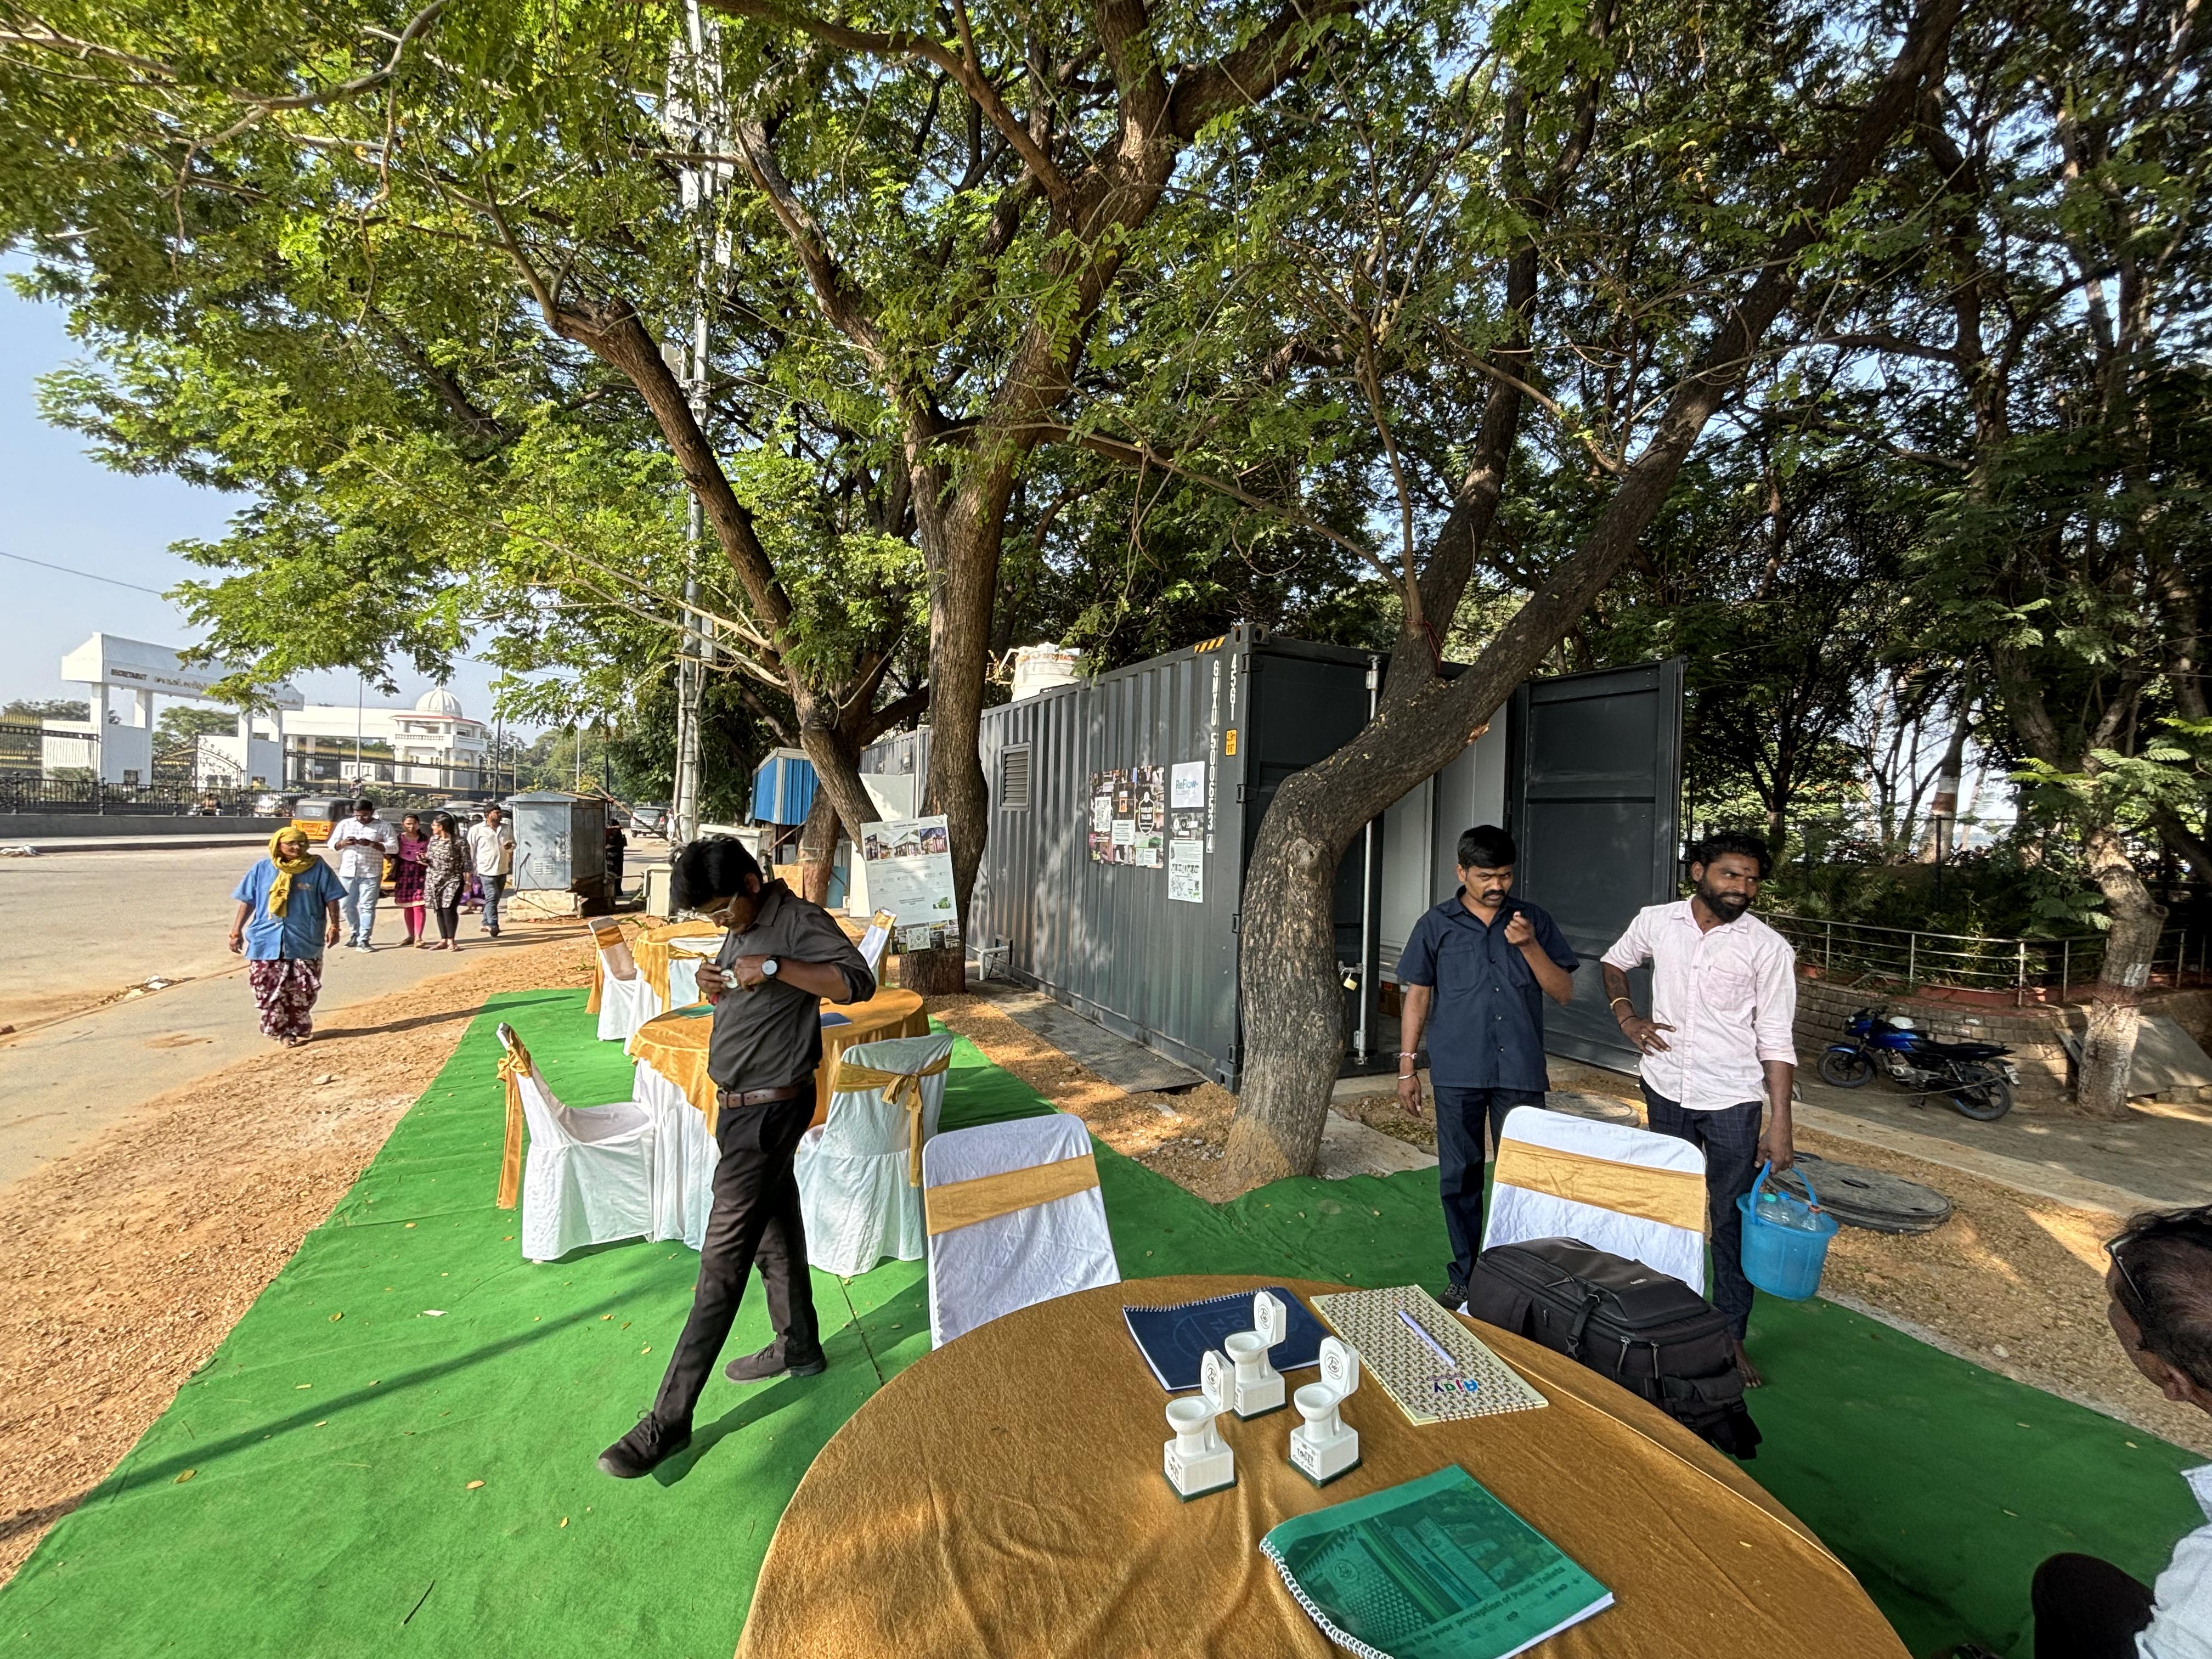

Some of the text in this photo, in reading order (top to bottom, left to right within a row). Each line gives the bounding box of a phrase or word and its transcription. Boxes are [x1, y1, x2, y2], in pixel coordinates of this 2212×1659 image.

[1206, 660, 1219, 852] GMXU 500653 4
